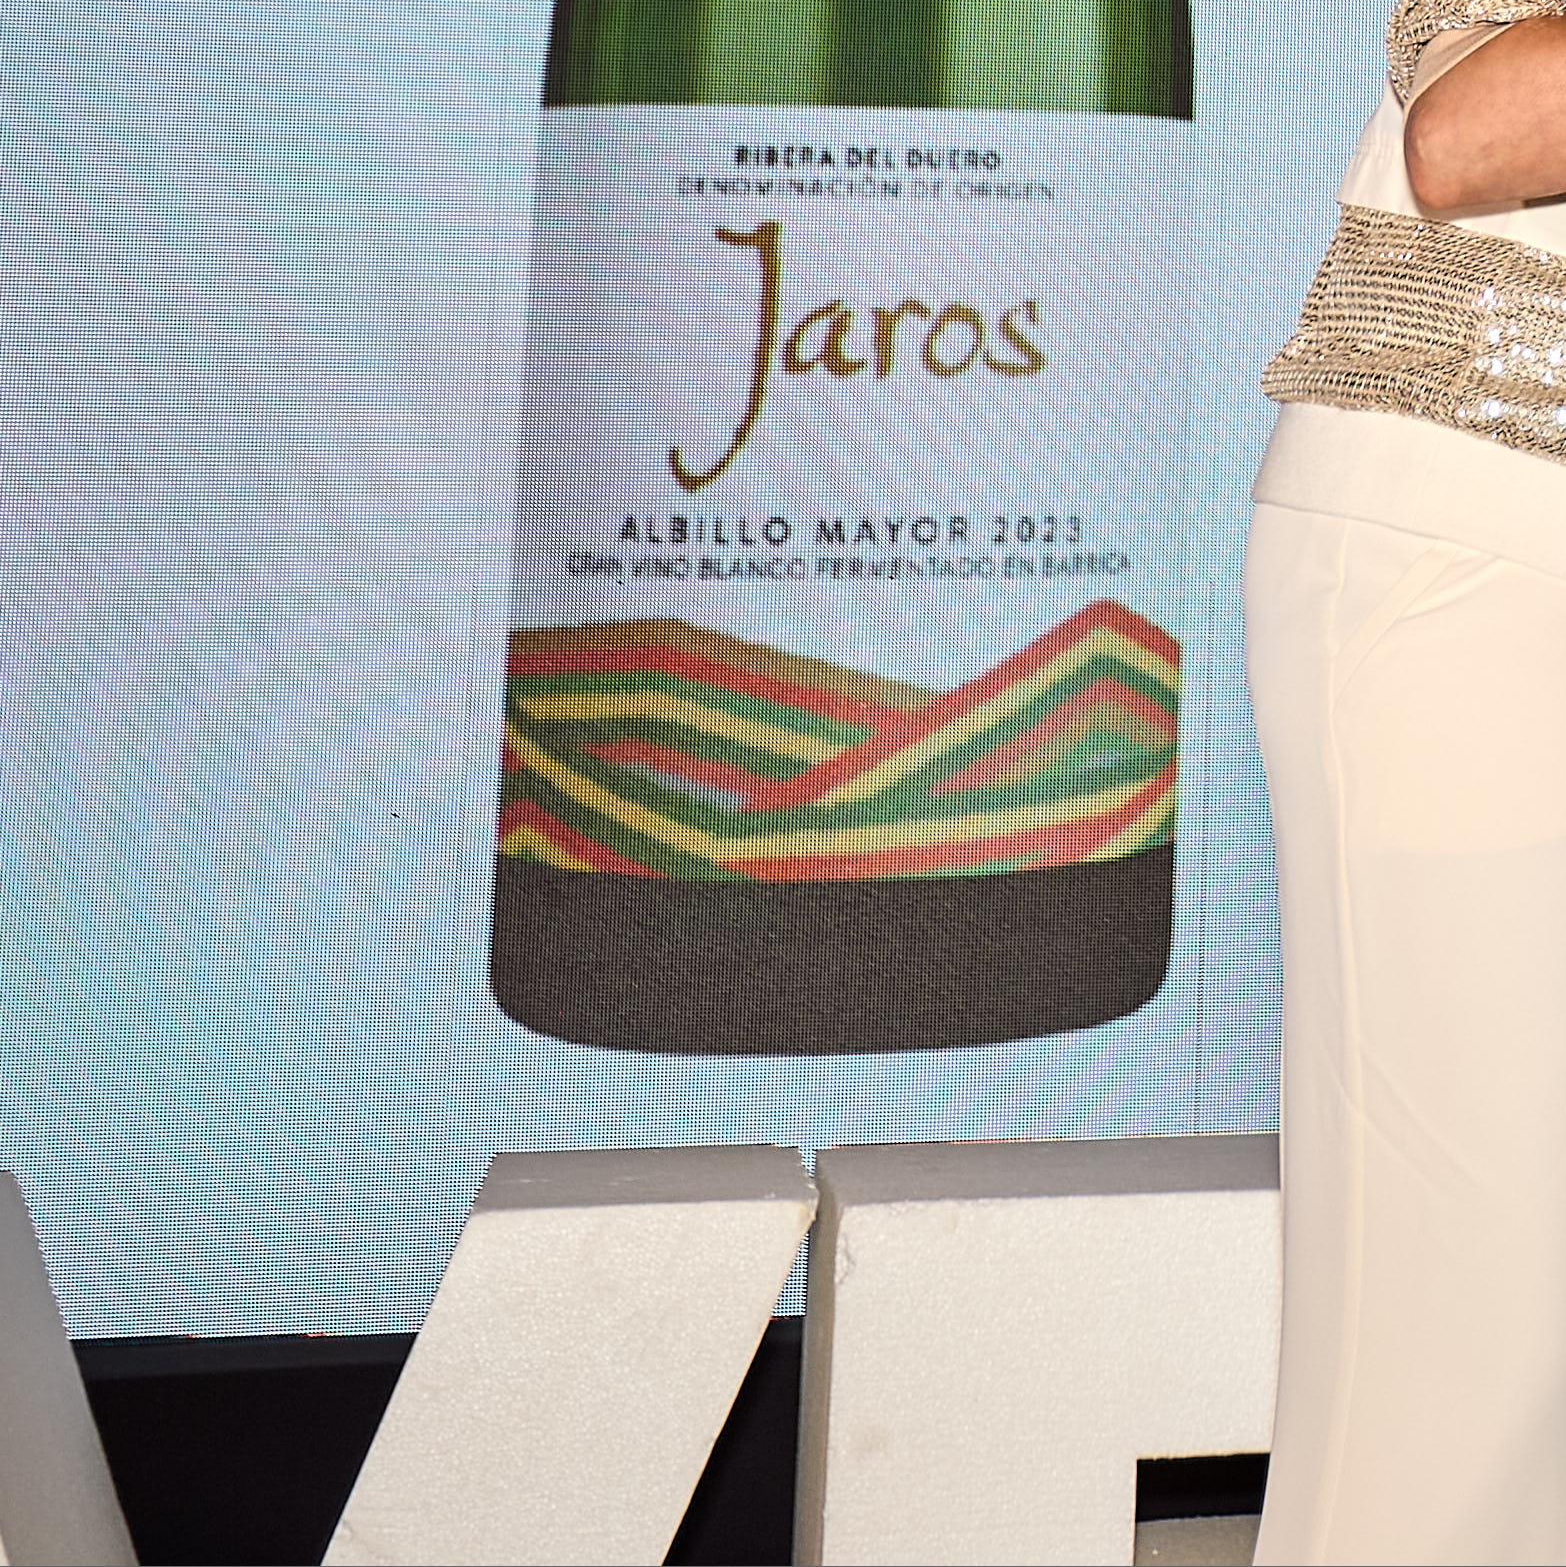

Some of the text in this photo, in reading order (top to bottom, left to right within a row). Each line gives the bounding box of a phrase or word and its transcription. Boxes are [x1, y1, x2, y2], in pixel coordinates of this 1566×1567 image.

[733, 145, 1004, 171] RIBERA DEL DUERO
[665, 218, 1048, 495] Jaros
[618, 513, 1085, 547] ALBILLO MAYOR 2023
[698, 555, 808, 582] BLANCO
